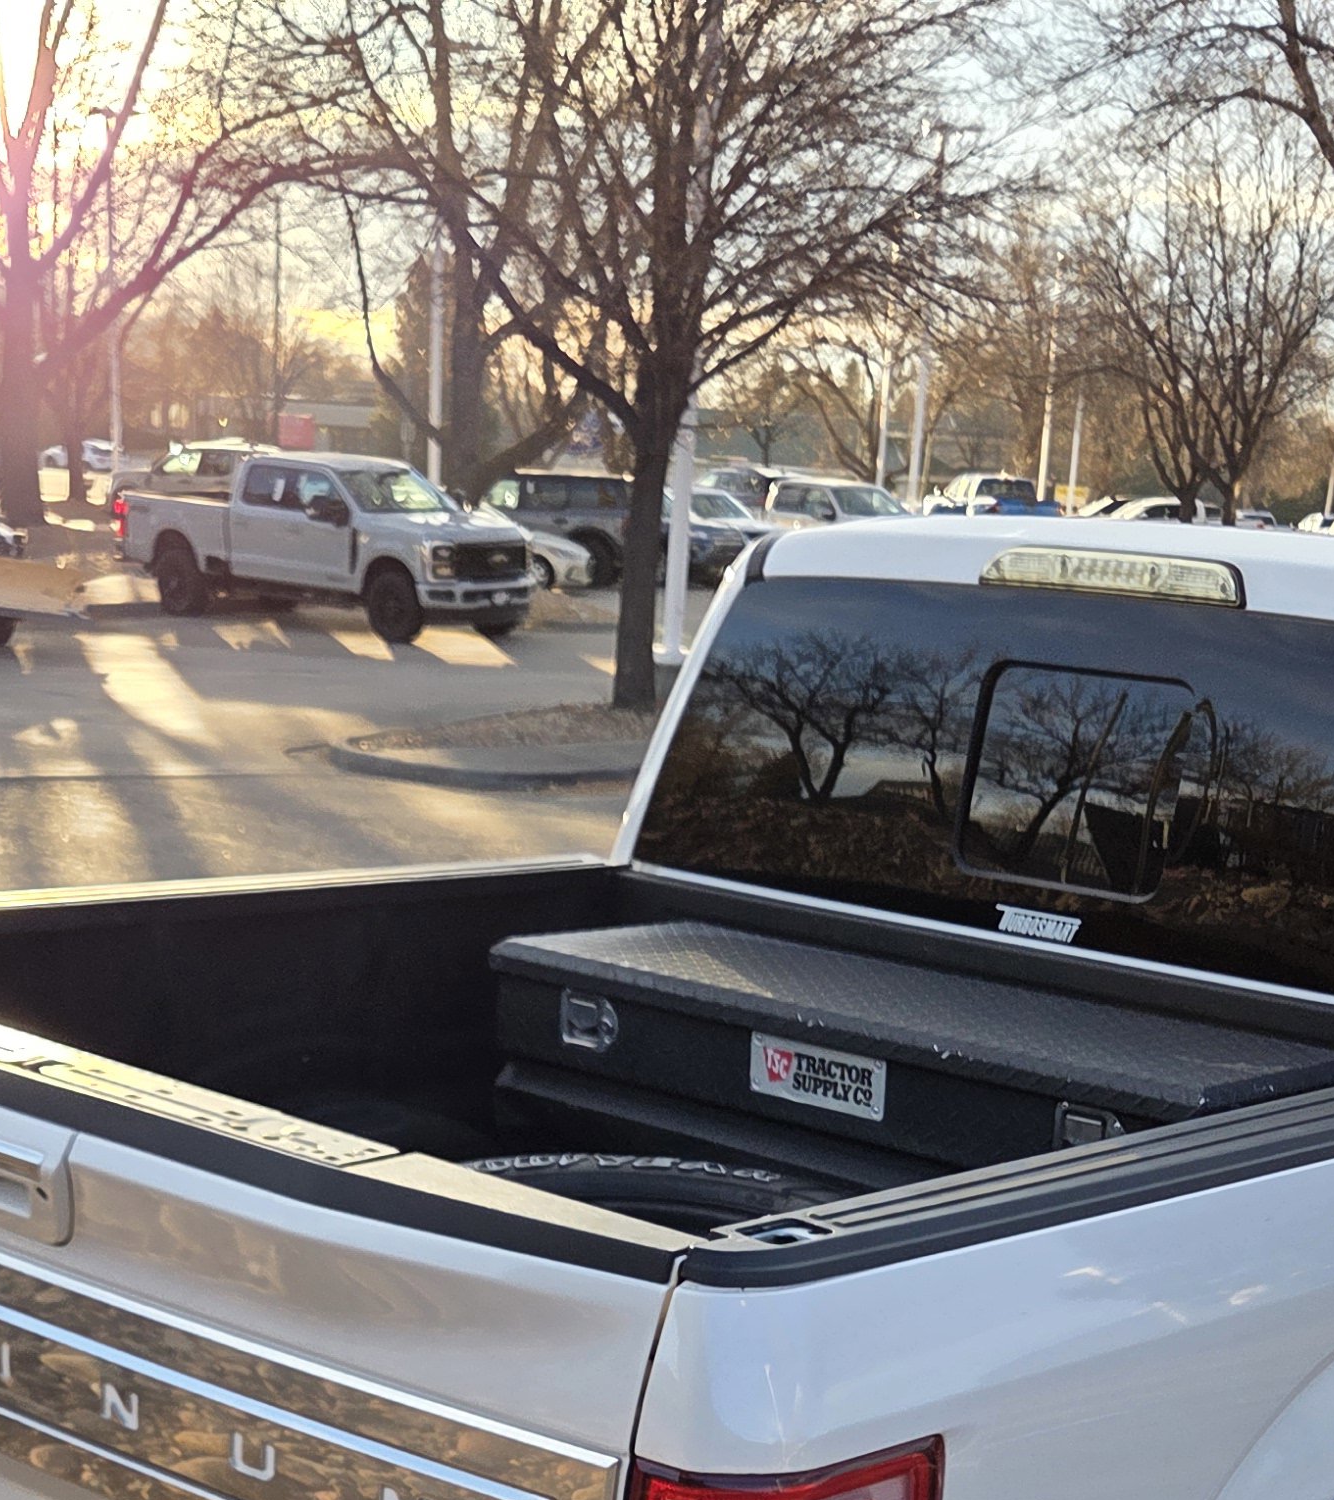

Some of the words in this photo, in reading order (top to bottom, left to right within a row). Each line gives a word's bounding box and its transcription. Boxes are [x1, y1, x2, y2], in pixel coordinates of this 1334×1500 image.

[767, 1048, 788, 1080] TSC
[793, 1052, 873, 1088] TRACTOR
[792, 1072, 852, 1103] SUPPLY
